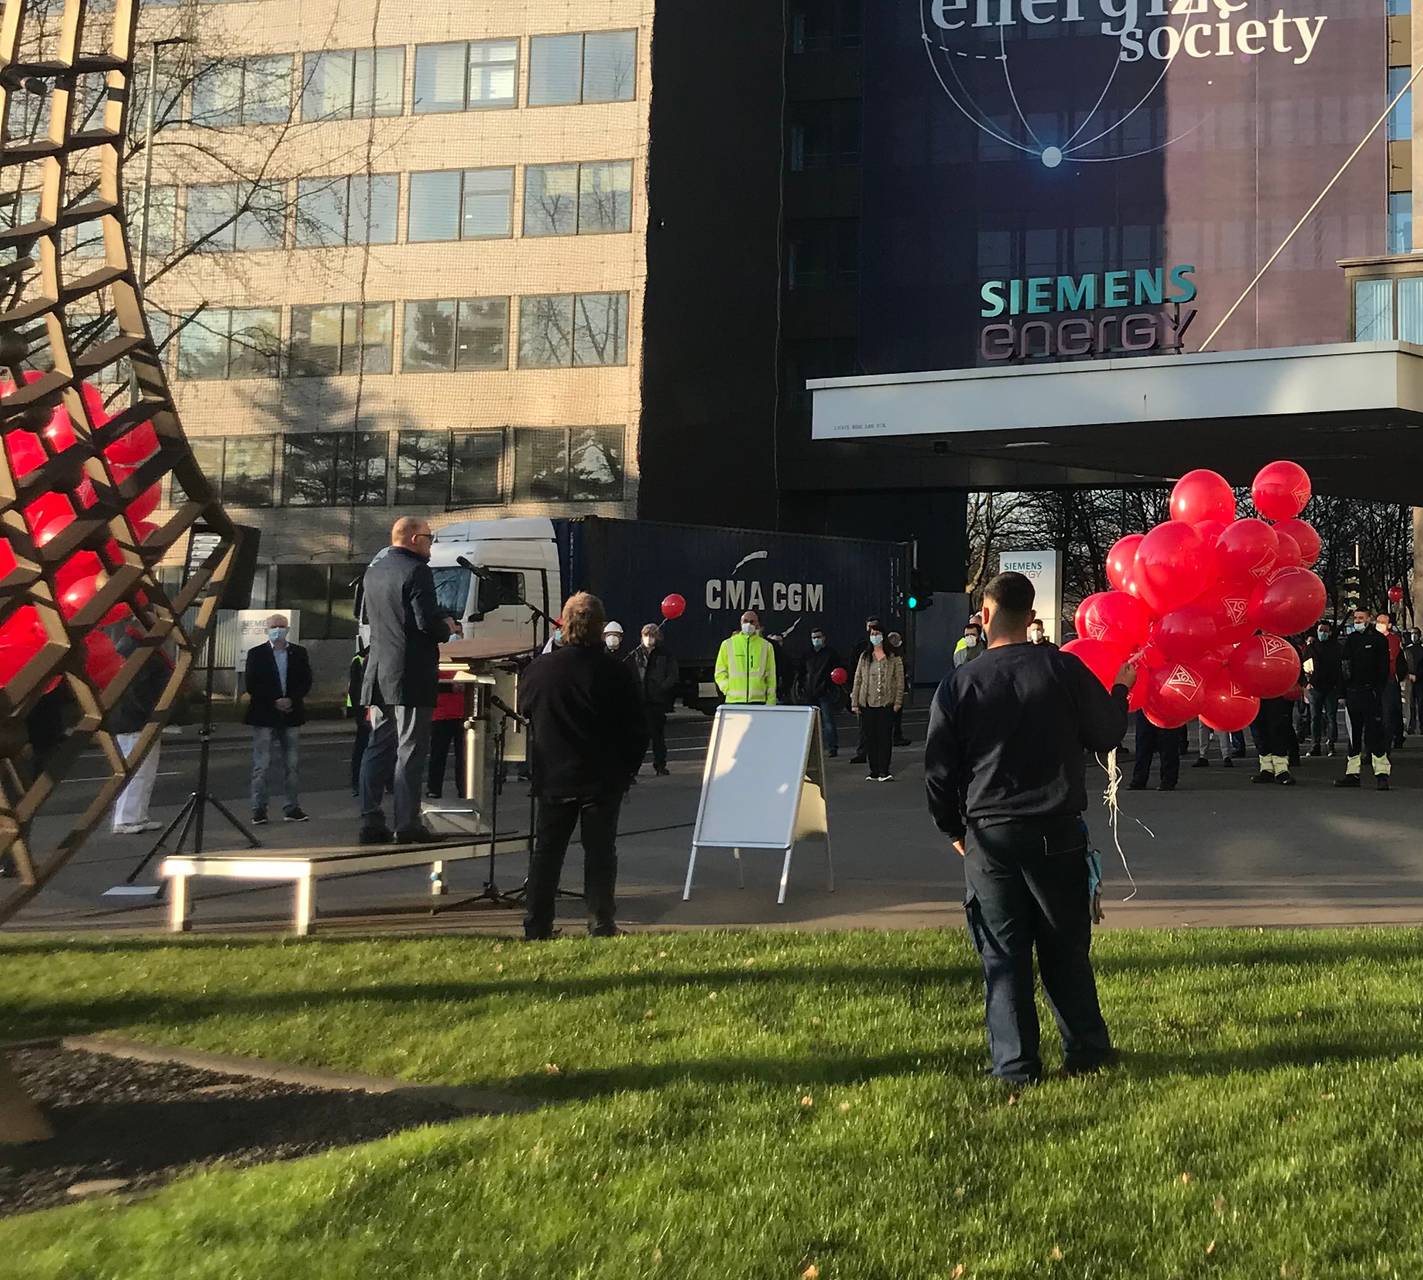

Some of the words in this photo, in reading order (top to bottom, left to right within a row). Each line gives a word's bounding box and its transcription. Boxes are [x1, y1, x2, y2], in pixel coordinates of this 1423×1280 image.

[1119, 8, 1328, 65] society
[980, 264, 1197, 319] SIEMENS
[1003, 561, 1043, 571] SIEMENS
[706, 578, 766, 611] CMA
[772, 582, 825, 612] CGM
